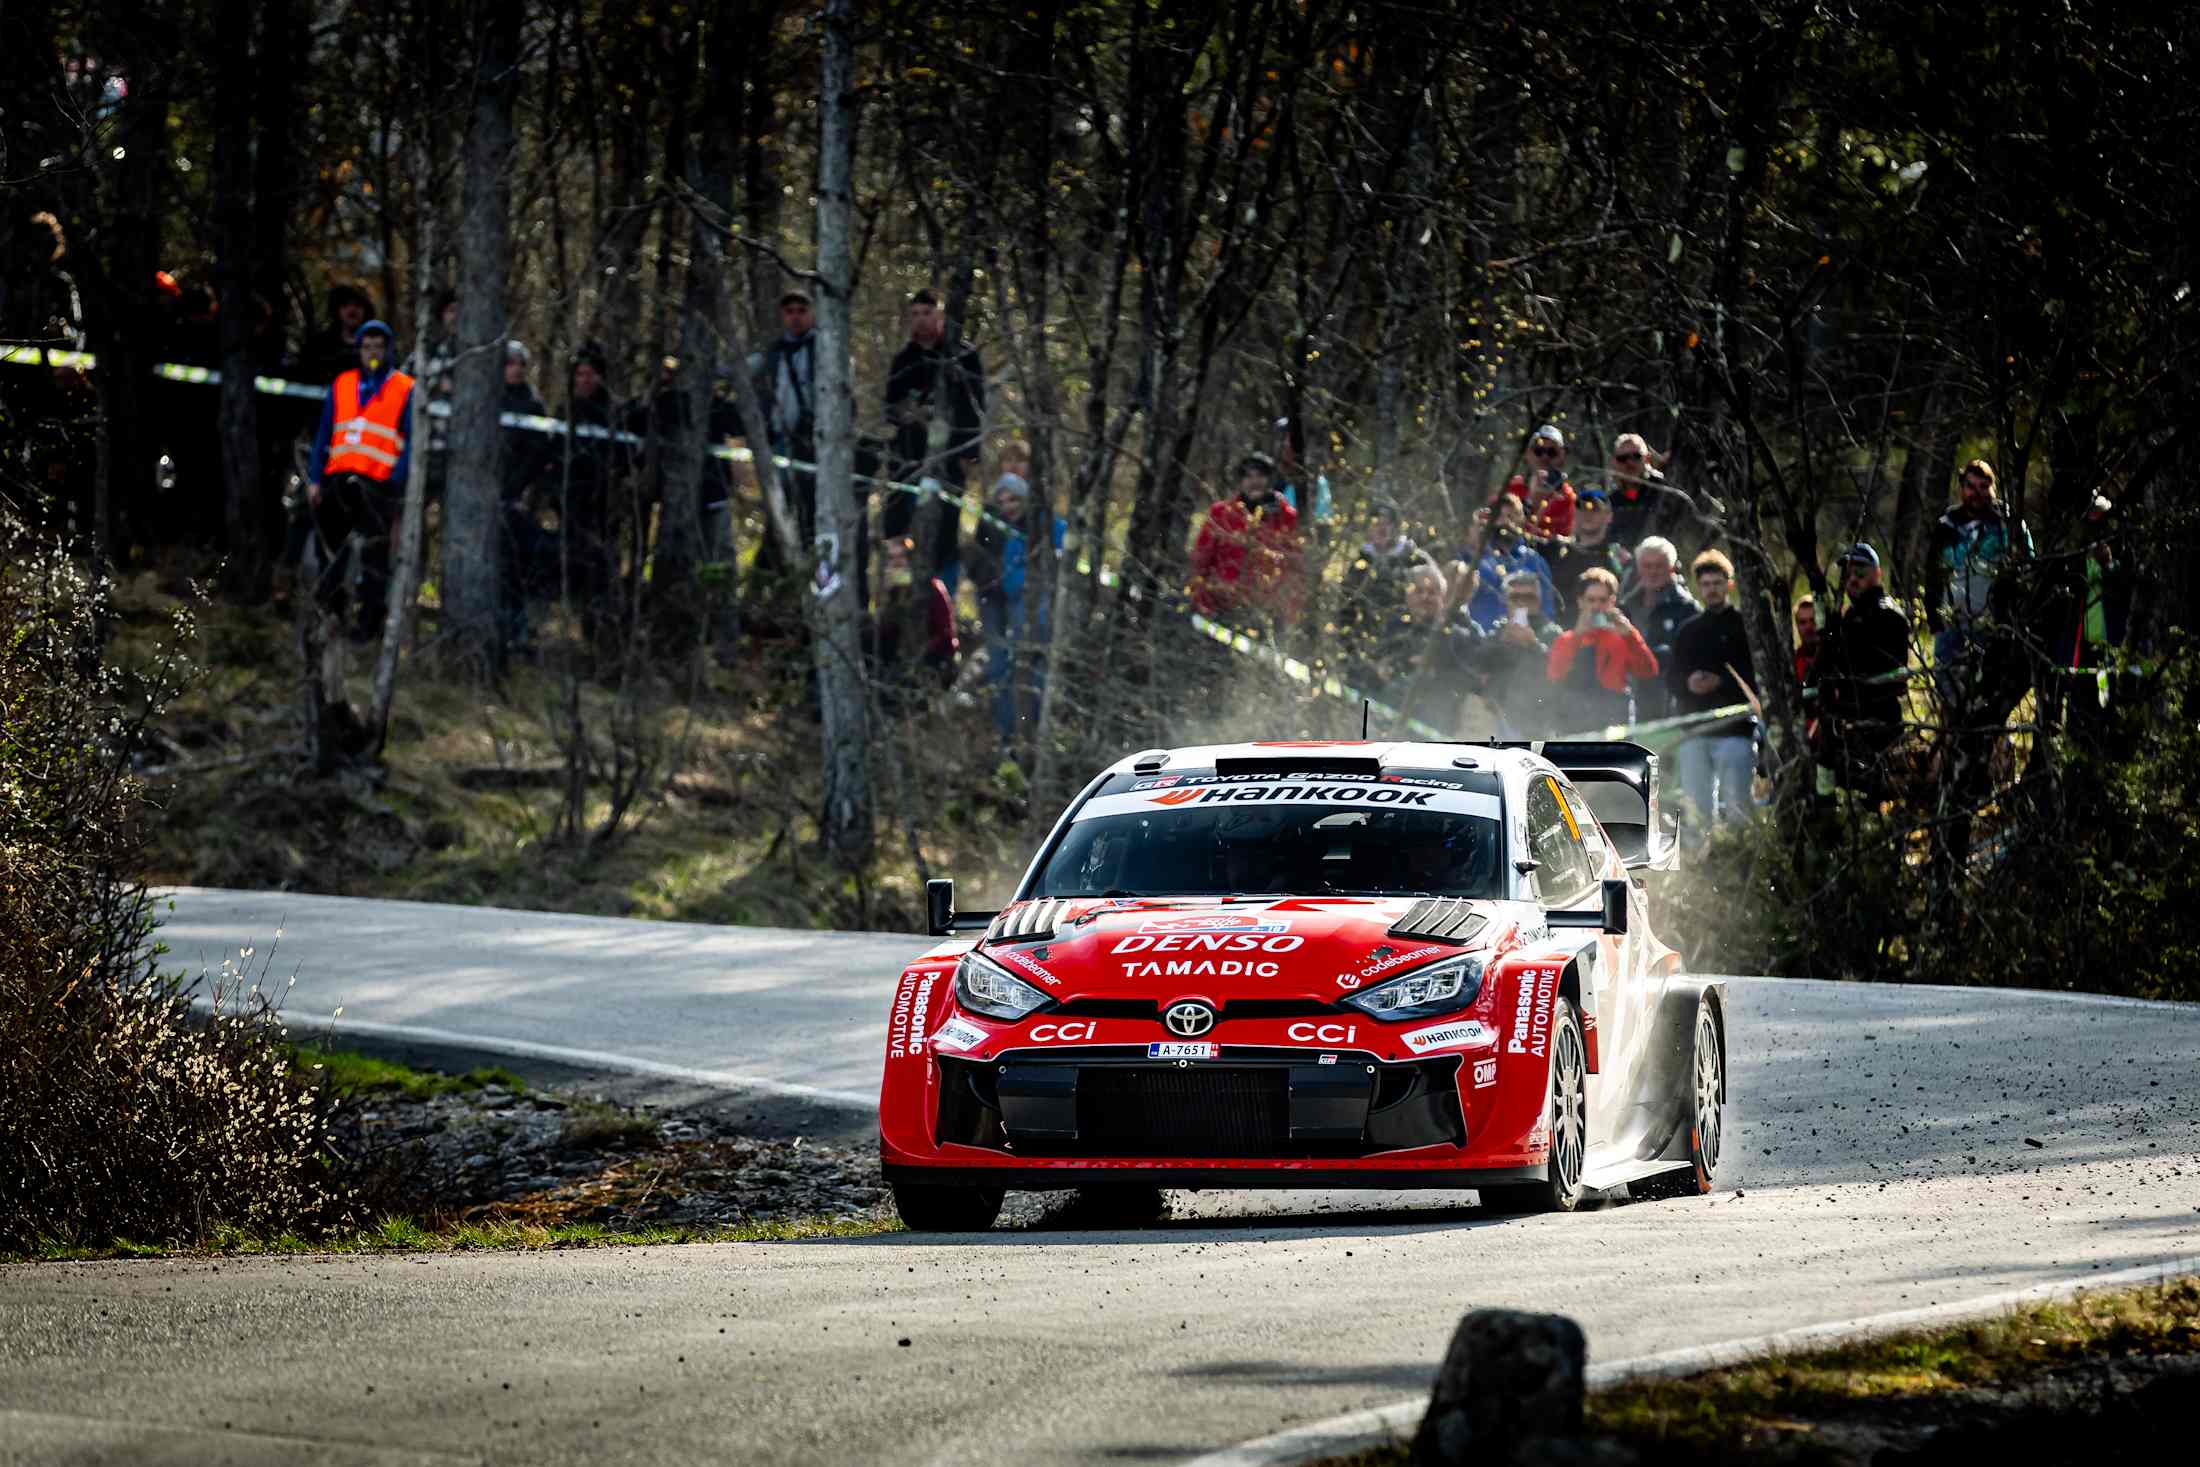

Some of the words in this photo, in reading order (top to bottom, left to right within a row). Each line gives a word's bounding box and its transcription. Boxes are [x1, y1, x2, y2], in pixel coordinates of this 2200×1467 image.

[1187, 773, 1281, 784] TOYOTA
[1285, 772, 1376, 781] GAZOO
[1379, 775, 1464, 790] Racing
[1110, 934, 1305, 954] DENSO
[1006, 951, 1062, 986] codebeamer
[1121, 960, 1280, 977] TAMADIC
[1361, 945, 1441, 977] codebeamer
[890, 972, 920, 1059] AUTOMOTIVE
[908, 971, 942, 1055] Panasonic
[1507, 969, 1537, 1054] Panasonic
[1530, 968, 1556, 1058] AUTOMOTIVE
[1162, 1045, 1206, 1055] A-7651
[1473, 1062, 1497, 1084] OMP
